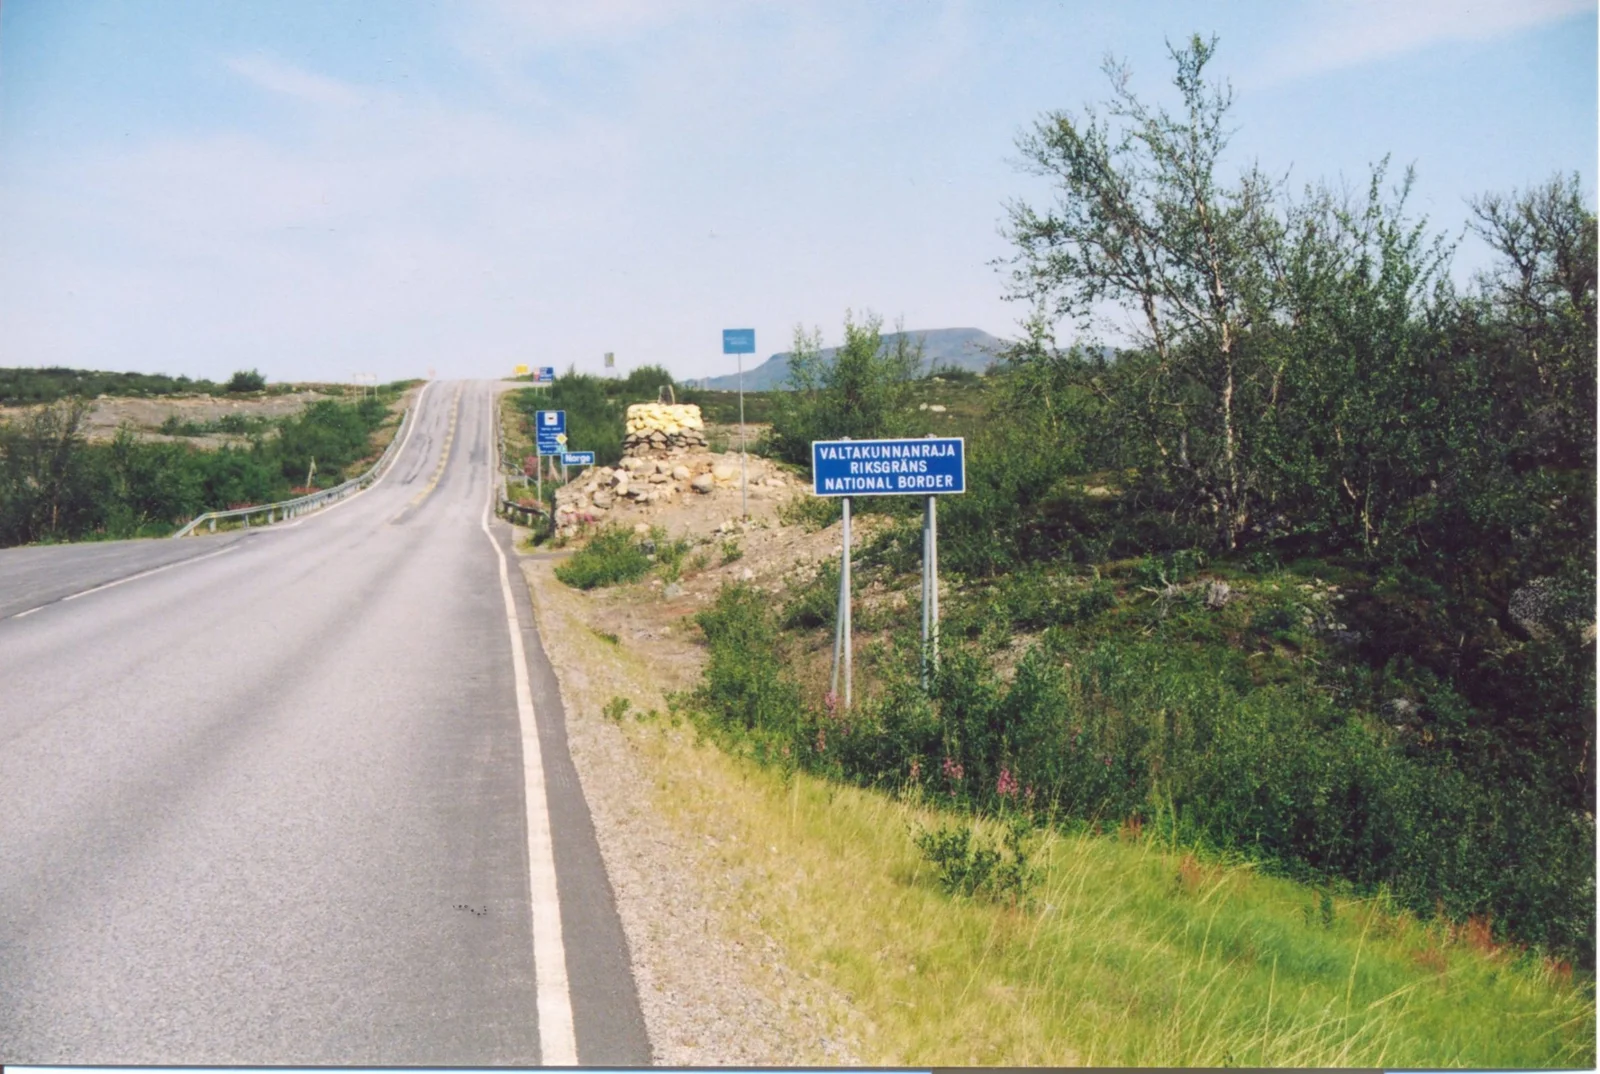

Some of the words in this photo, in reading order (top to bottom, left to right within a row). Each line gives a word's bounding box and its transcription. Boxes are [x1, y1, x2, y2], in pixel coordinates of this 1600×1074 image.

[565, 454, 591, 464] Norge
[820, 444, 955, 460] VALTAKUNNANRAJA
[850, 459, 928, 474] RIKSGRÄNS
[825, 477, 893, 490] NATIONAL
[898, 475, 953, 488] BORDER
